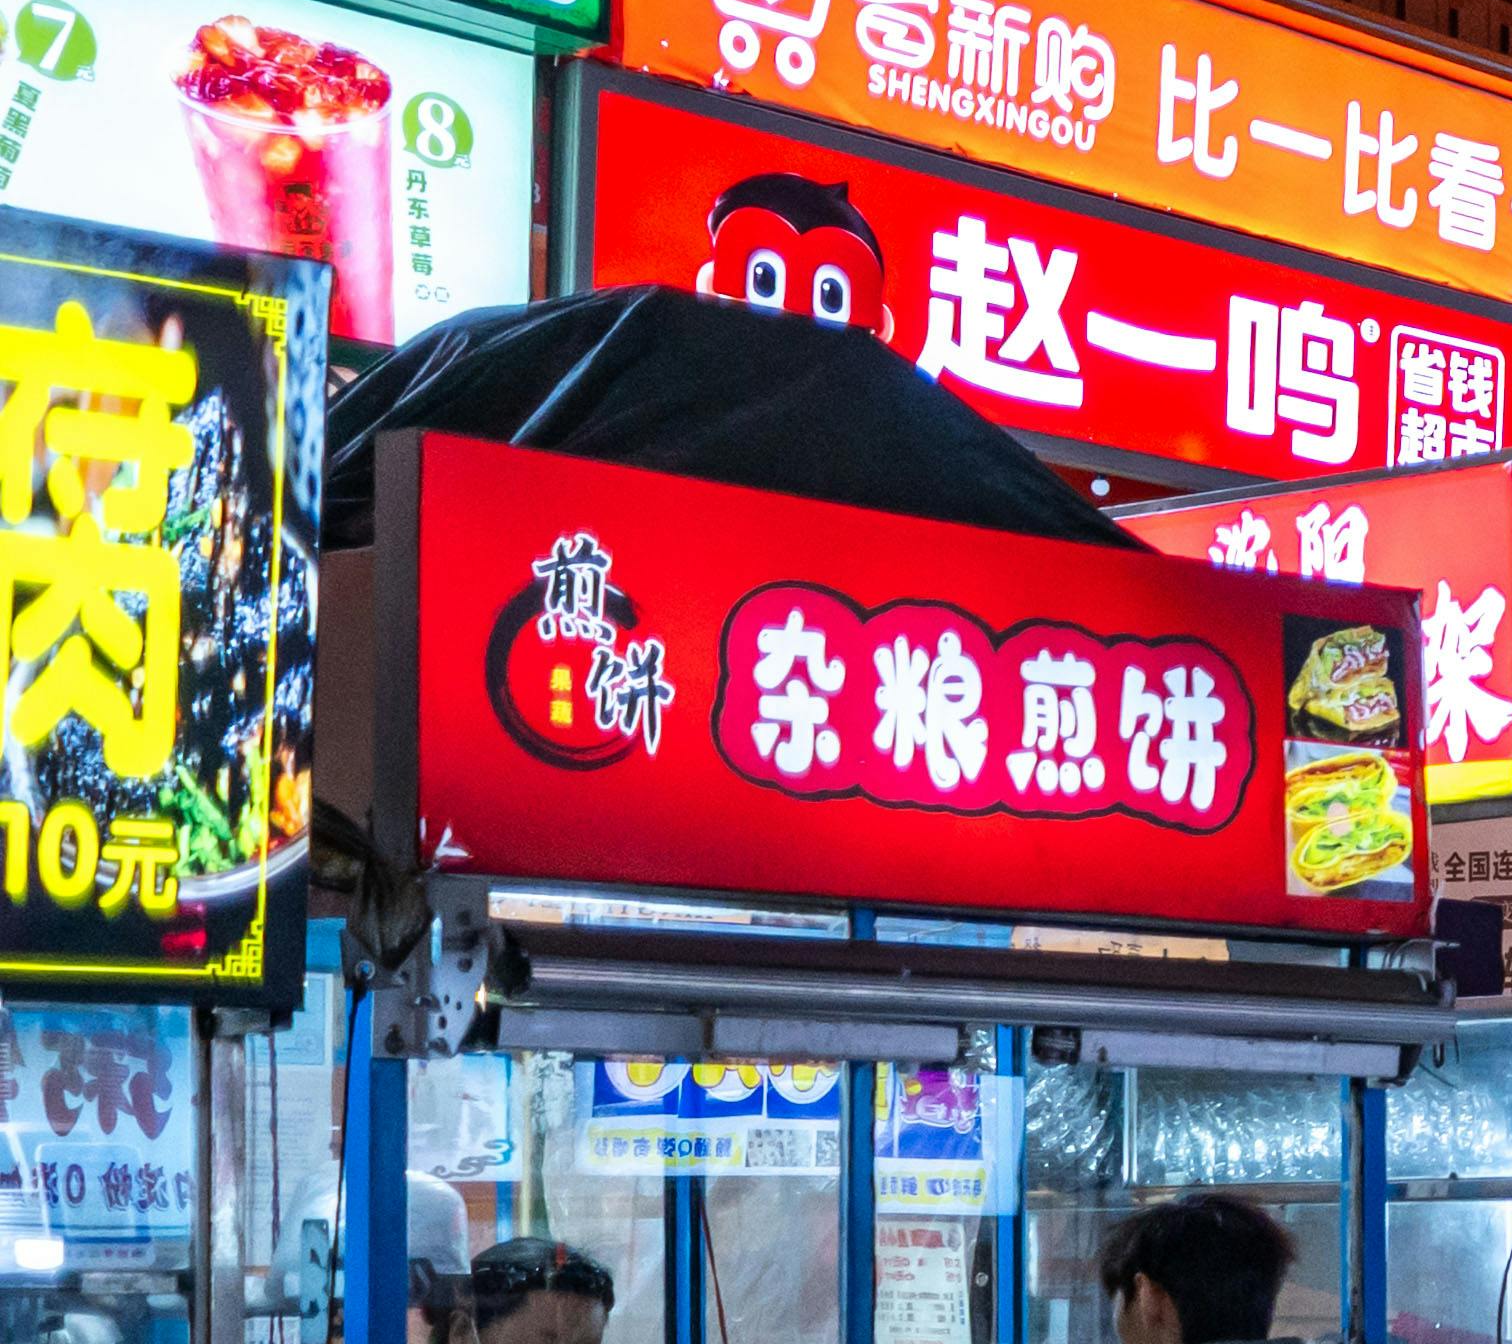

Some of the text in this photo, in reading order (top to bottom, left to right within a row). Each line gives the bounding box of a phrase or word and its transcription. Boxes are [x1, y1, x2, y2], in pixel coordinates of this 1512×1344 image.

[867, 64, 1096, 151] SHENGXINGOU
[406, 169, 434, 276] 丹东草莓
[915, 215, 1360, 465] 赵一鸣
[1401, 339, 1494, 415] 省钱
[748, 609, 1228, 813] 杂粮煎饼
